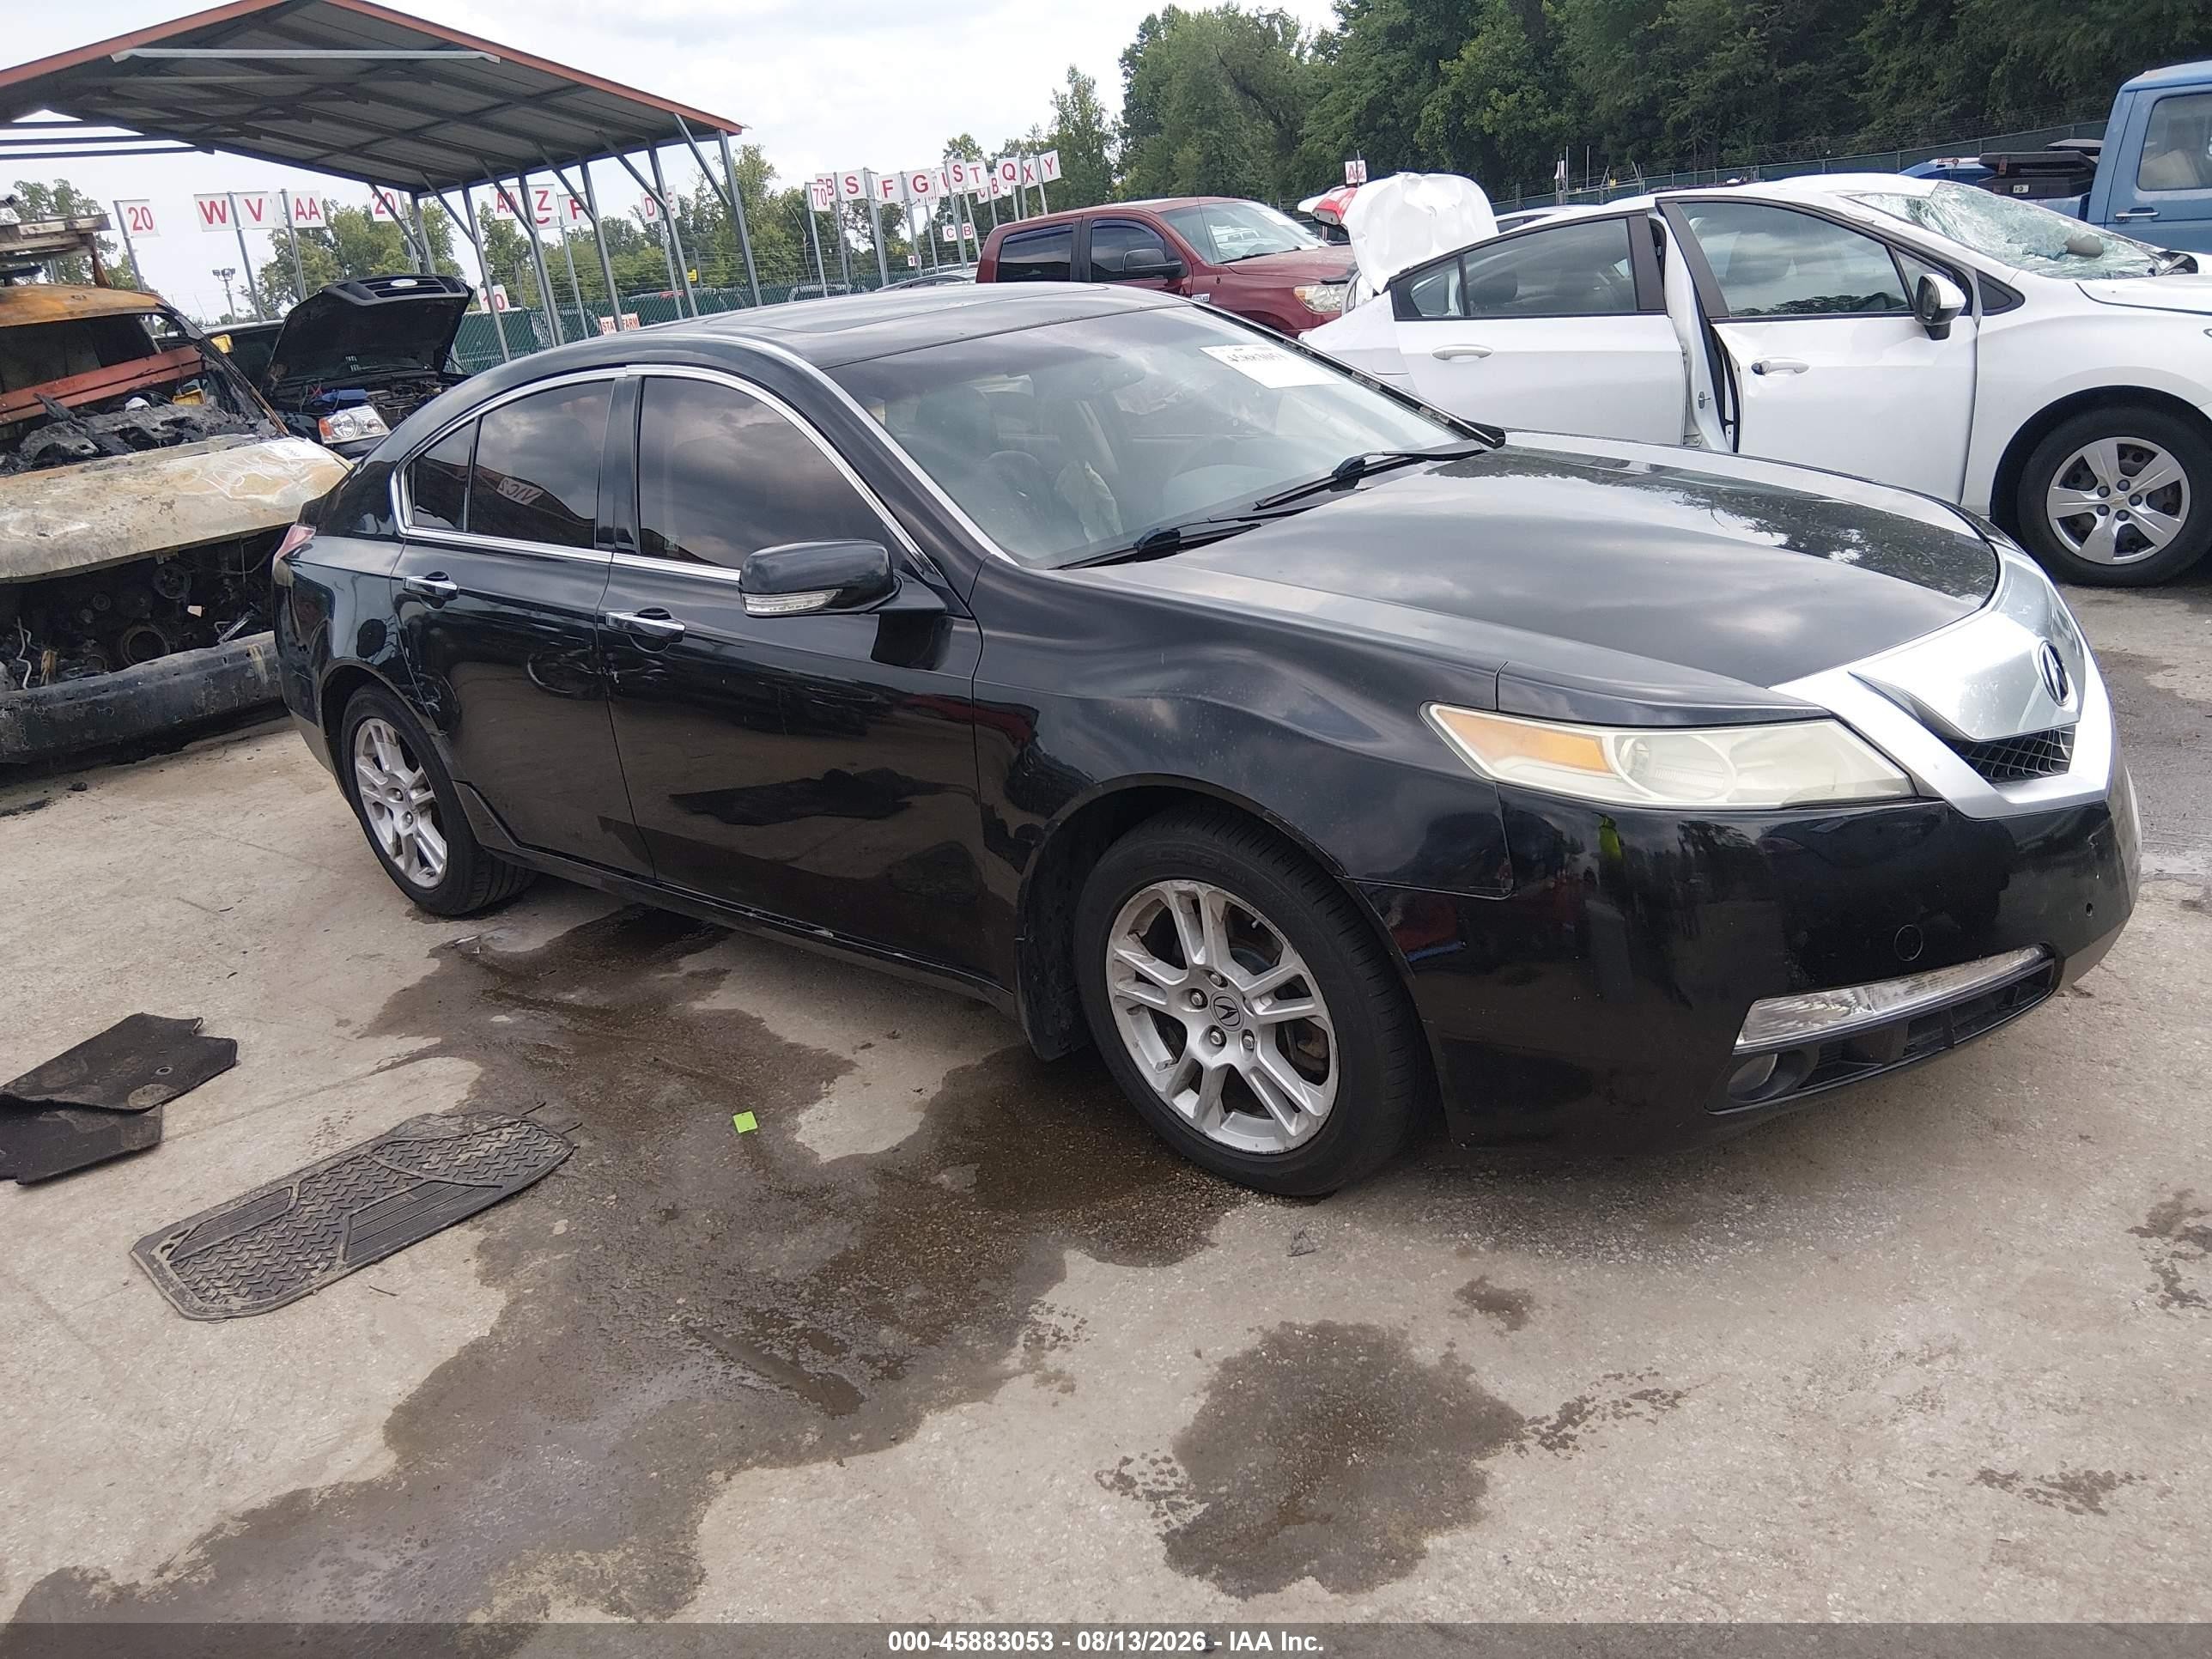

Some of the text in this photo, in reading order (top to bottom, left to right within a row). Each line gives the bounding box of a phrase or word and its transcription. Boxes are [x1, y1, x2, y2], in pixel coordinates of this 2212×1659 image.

[952, 164, 963, 182] S
[969, 167, 981, 184] T
[1002, 163, 1016, 181] Q
[1024, 164, 1035, 185] X
[1044, 157, 1054, 175] Y
[845, 176, 860, 194] S
[882, 179, 893, 198] F
[912, 174, 929, 193] G
[991, 178, 999, 194] B
[372, 191, 396, 215] 20
[535, 191, 552, 211] Z
[644, 197, 654, 216] D
[812, 188, 827, 206] 70
[128, 206, 154, 231] 20
[198, 200, 227, 224] W
[245, 198, 262, 221] V
[295, 197, 321, 221] AA
[963, 225, 972, 236] B
